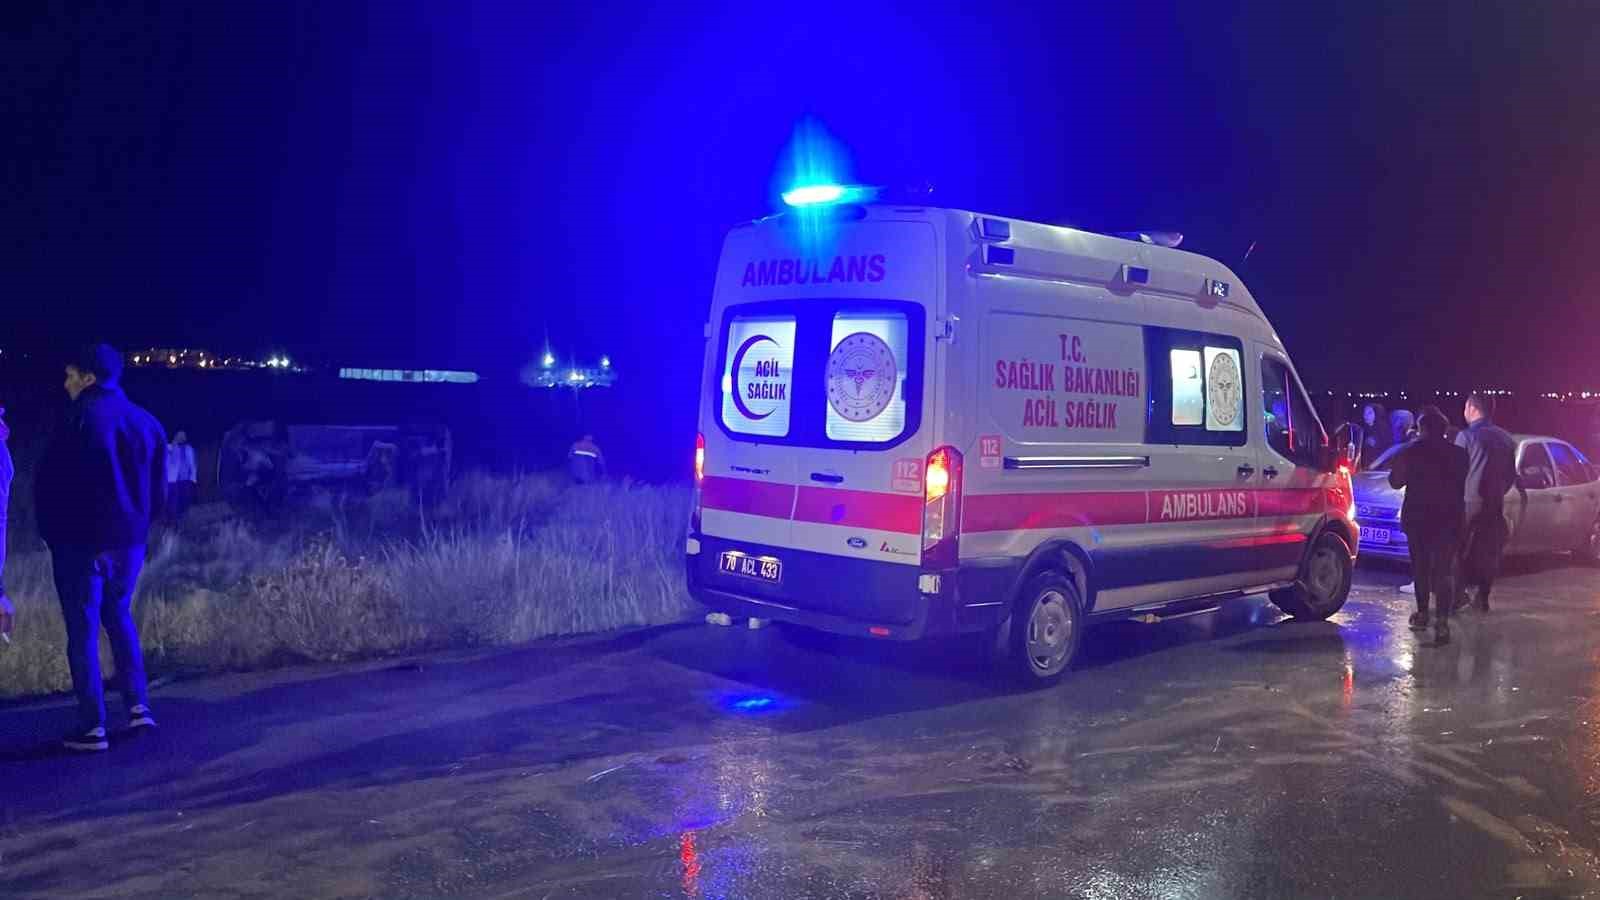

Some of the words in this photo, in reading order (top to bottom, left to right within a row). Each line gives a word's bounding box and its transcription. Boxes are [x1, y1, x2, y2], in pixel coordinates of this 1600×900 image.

[742, 254, 886, 287] AMBULANS
[1059, 334, 1087, 362] T.C.
[755, 357, 779, 377] ACİL
[996, 358, 1055, 392] SAĞLIK
[1064, 366, 1140, 398] BAKANLIĞI
[747, 380, 786, 401] SAĞLIK
[1023, 395, 1059, 428] ACİL
[1065, 398, 1117, 429] SAĞLIK
[1160, 492, 1246, 519] AMBULANS
[726, 555, 737, 571] 70
[760, 562, 778, 579] 433
